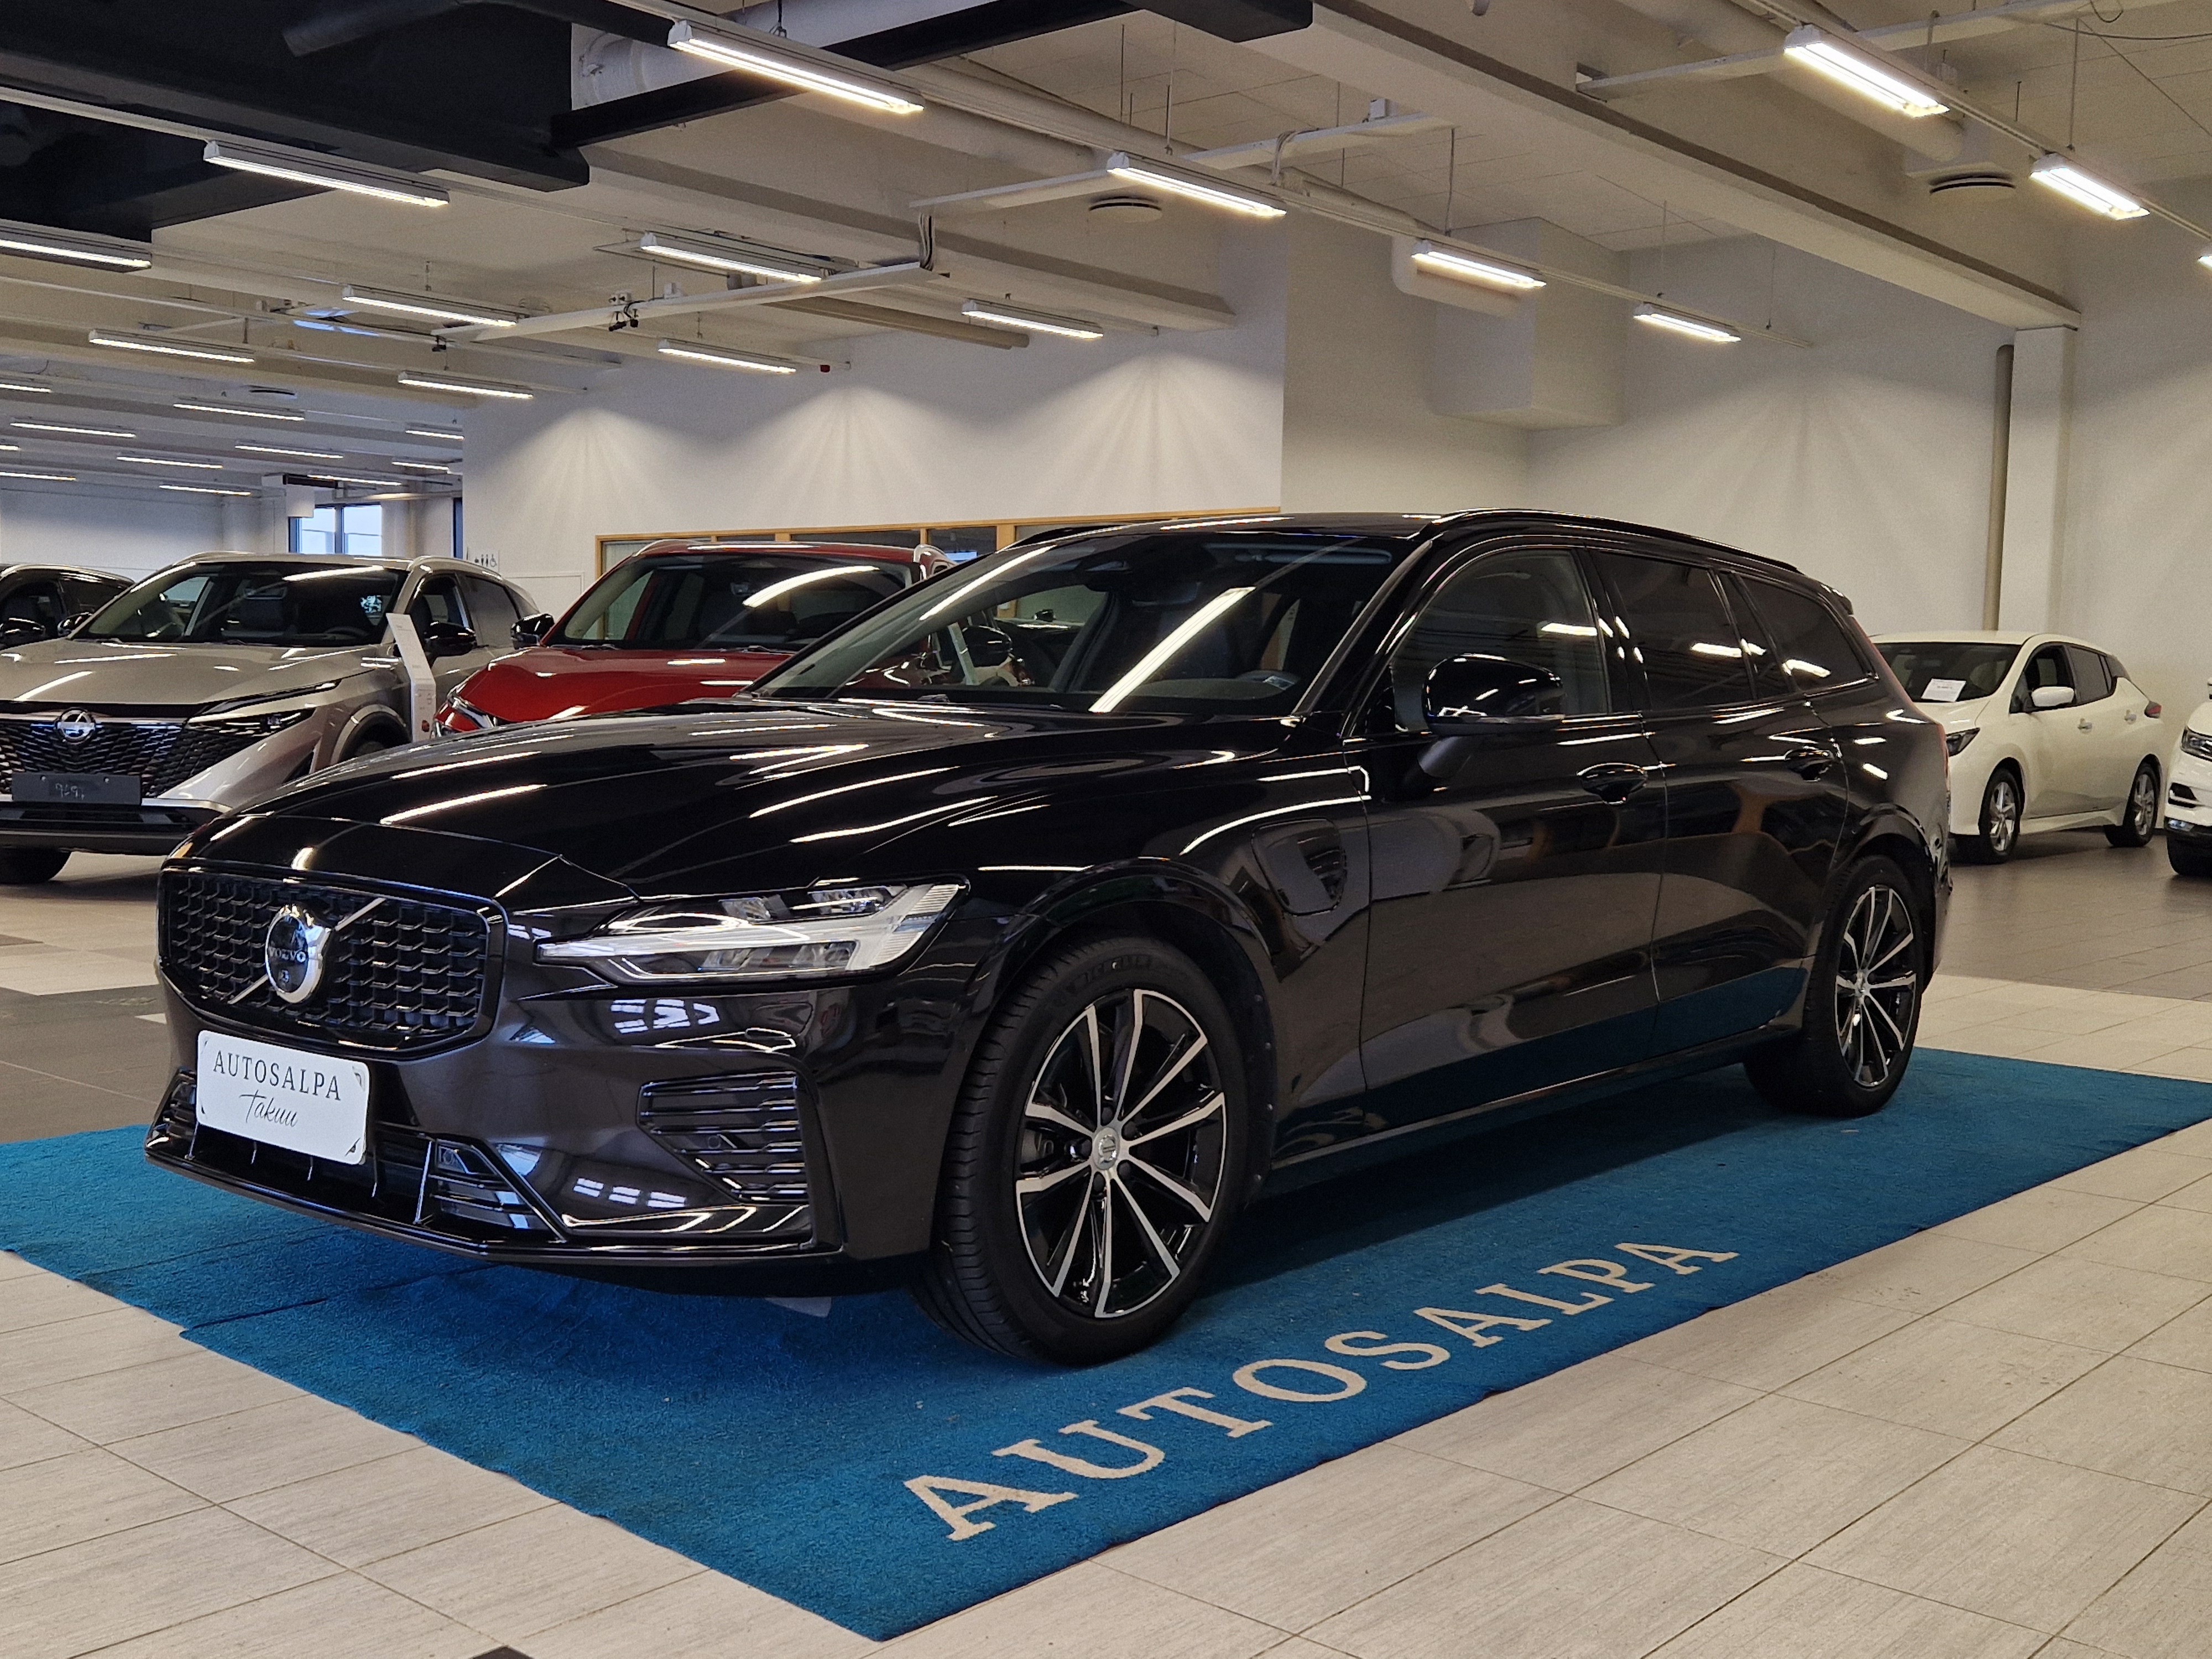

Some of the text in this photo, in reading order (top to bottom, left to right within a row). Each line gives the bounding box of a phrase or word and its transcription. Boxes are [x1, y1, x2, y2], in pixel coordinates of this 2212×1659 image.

[268, 946, 306, 963] VOLVO
[213, 1050, 341, 1100] AUTOSALPA
[239, 1089, 298, 1127] Takuu
[904, 1242, 1738, 1541] AUTOSALPA
